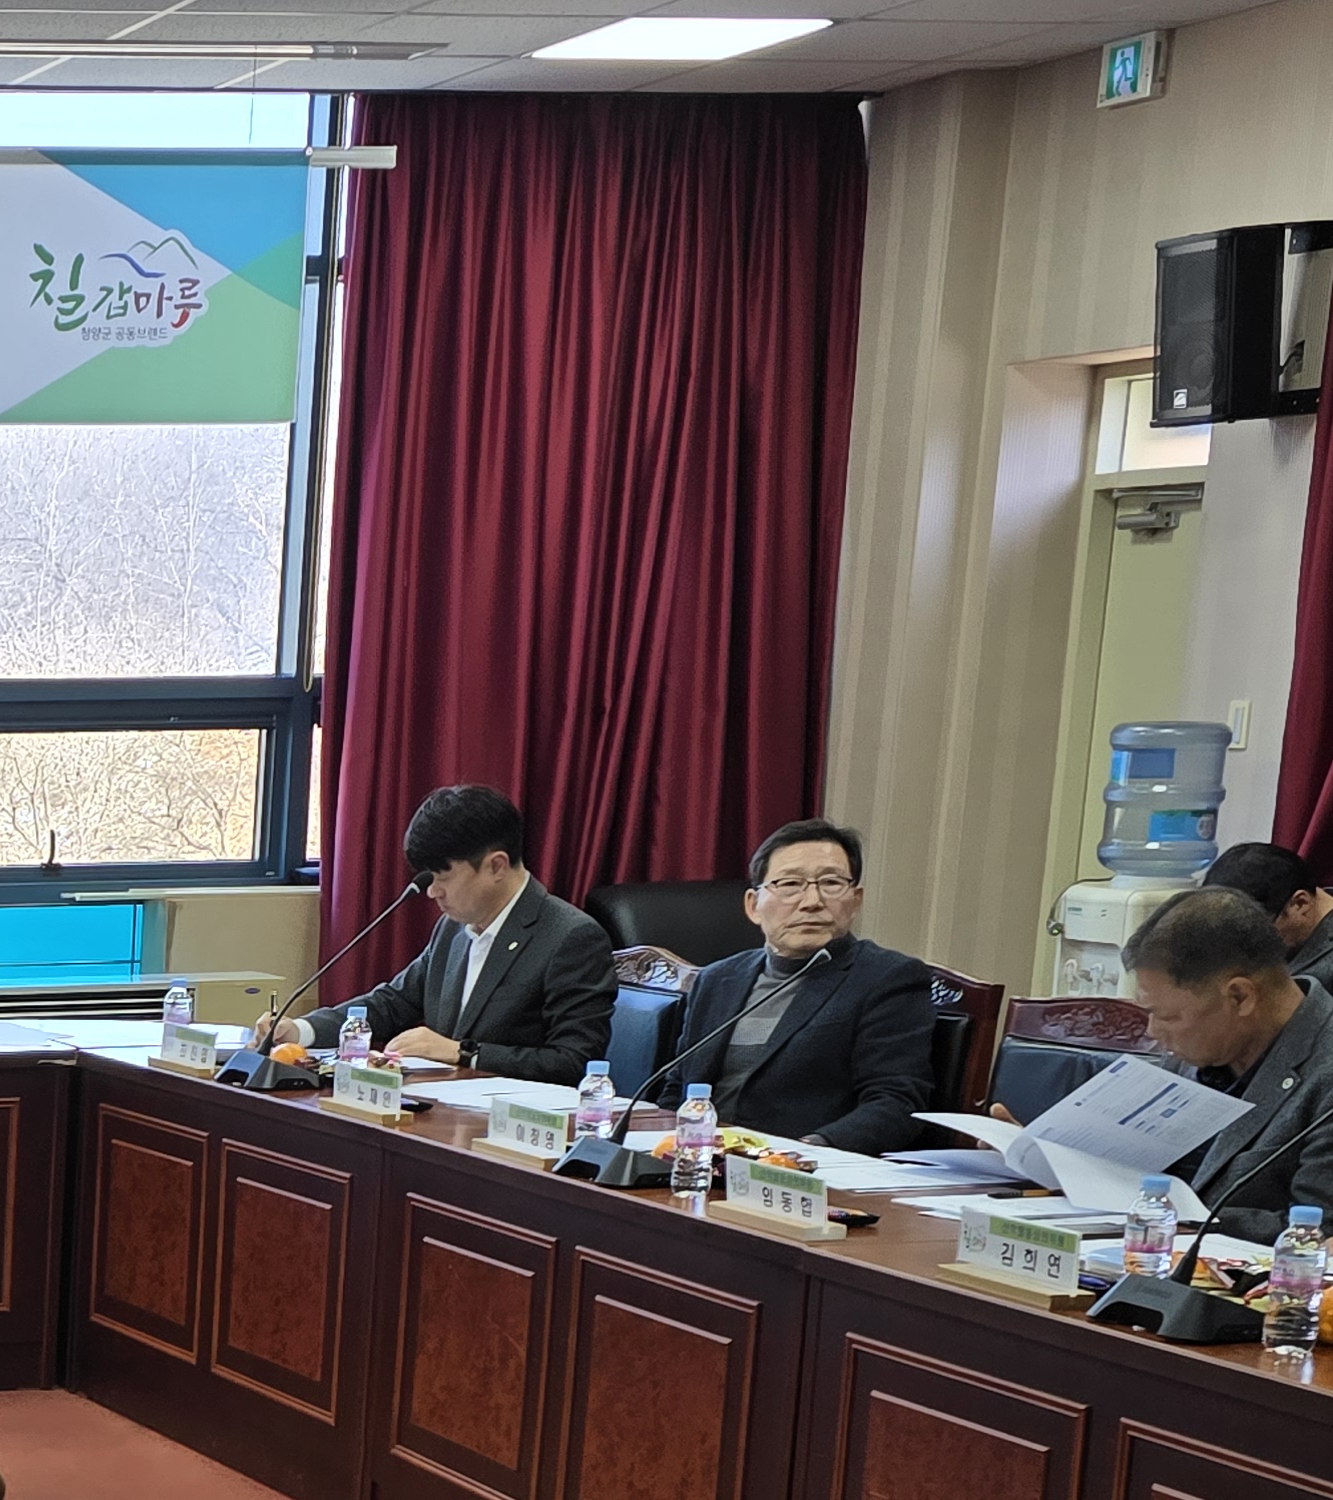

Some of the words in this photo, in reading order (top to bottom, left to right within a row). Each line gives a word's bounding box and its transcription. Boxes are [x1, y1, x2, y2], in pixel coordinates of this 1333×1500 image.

[28, 242, 204, 332] 칠갑마루
[80, 326, 112, 342] 청양군
[1000, 1242, 1062, 1280] 김희연
